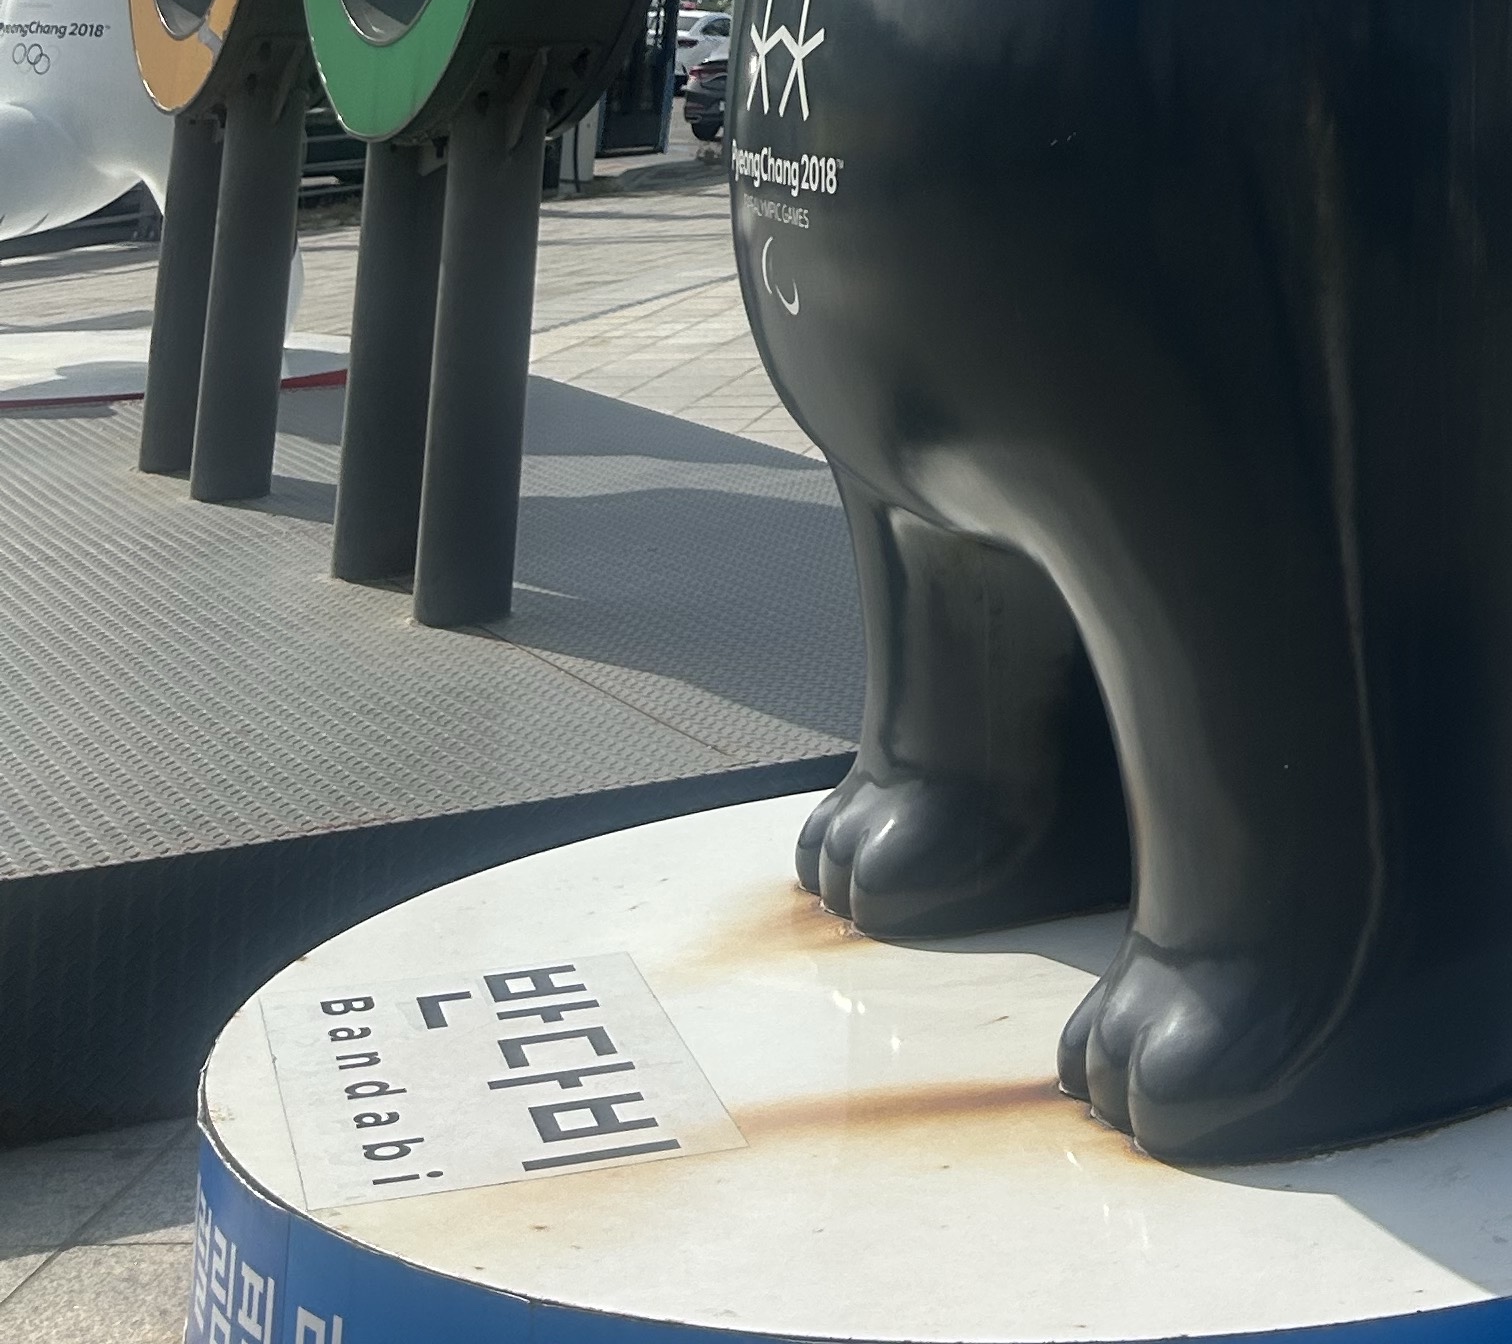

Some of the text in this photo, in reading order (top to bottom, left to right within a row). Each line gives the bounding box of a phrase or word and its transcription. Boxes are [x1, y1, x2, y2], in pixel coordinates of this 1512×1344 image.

[69, 22, 104, 38] 2018
[801, 154, 837, 194] 2018
[320, 996, 444, 1186] Bandabi
[193, 1173, 275, 1344] 럴림픽
